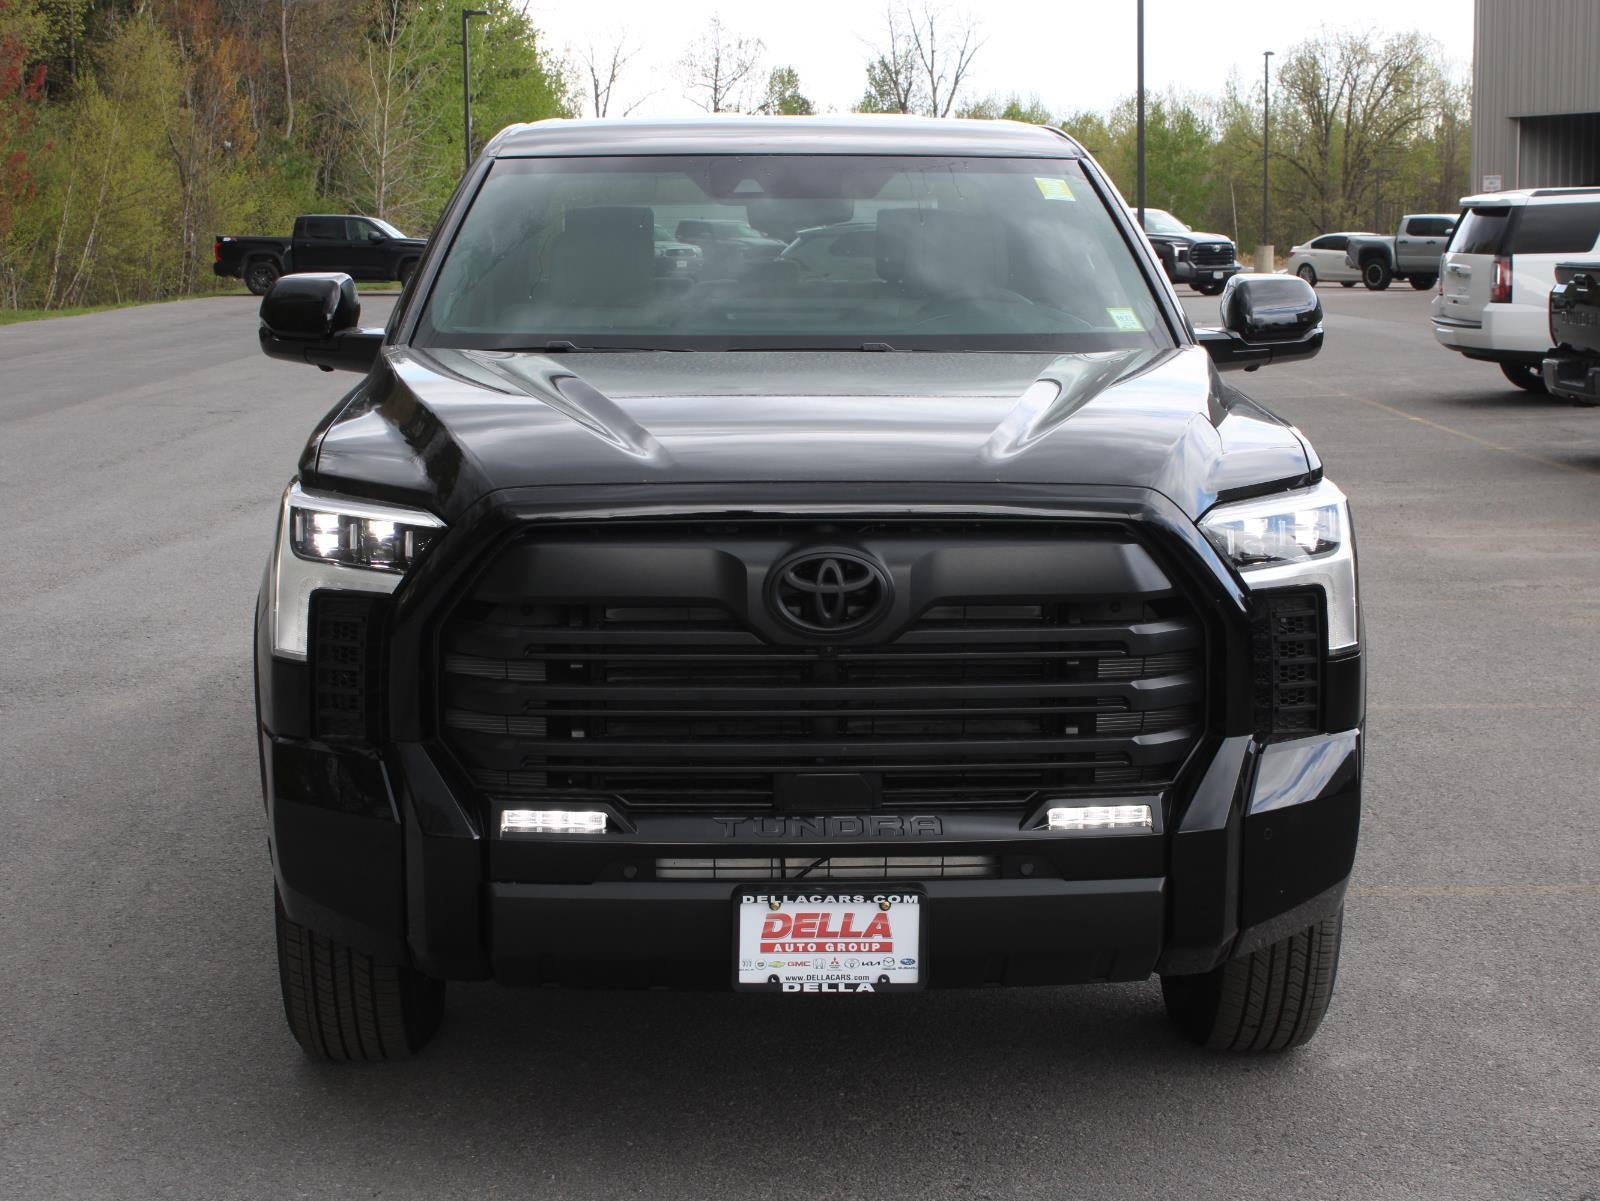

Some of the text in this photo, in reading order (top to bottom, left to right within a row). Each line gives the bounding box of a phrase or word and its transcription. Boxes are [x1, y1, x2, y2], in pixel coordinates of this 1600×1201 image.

[712, 815, 944, 837] TUNDRA
[742, 895, 919, 904] DELLACARS.COM
[760, 912, 893, 939] DELLA
[773, 943, 881, 952] AUTO GROUP
[782, 982, 875, 992] DELLA
